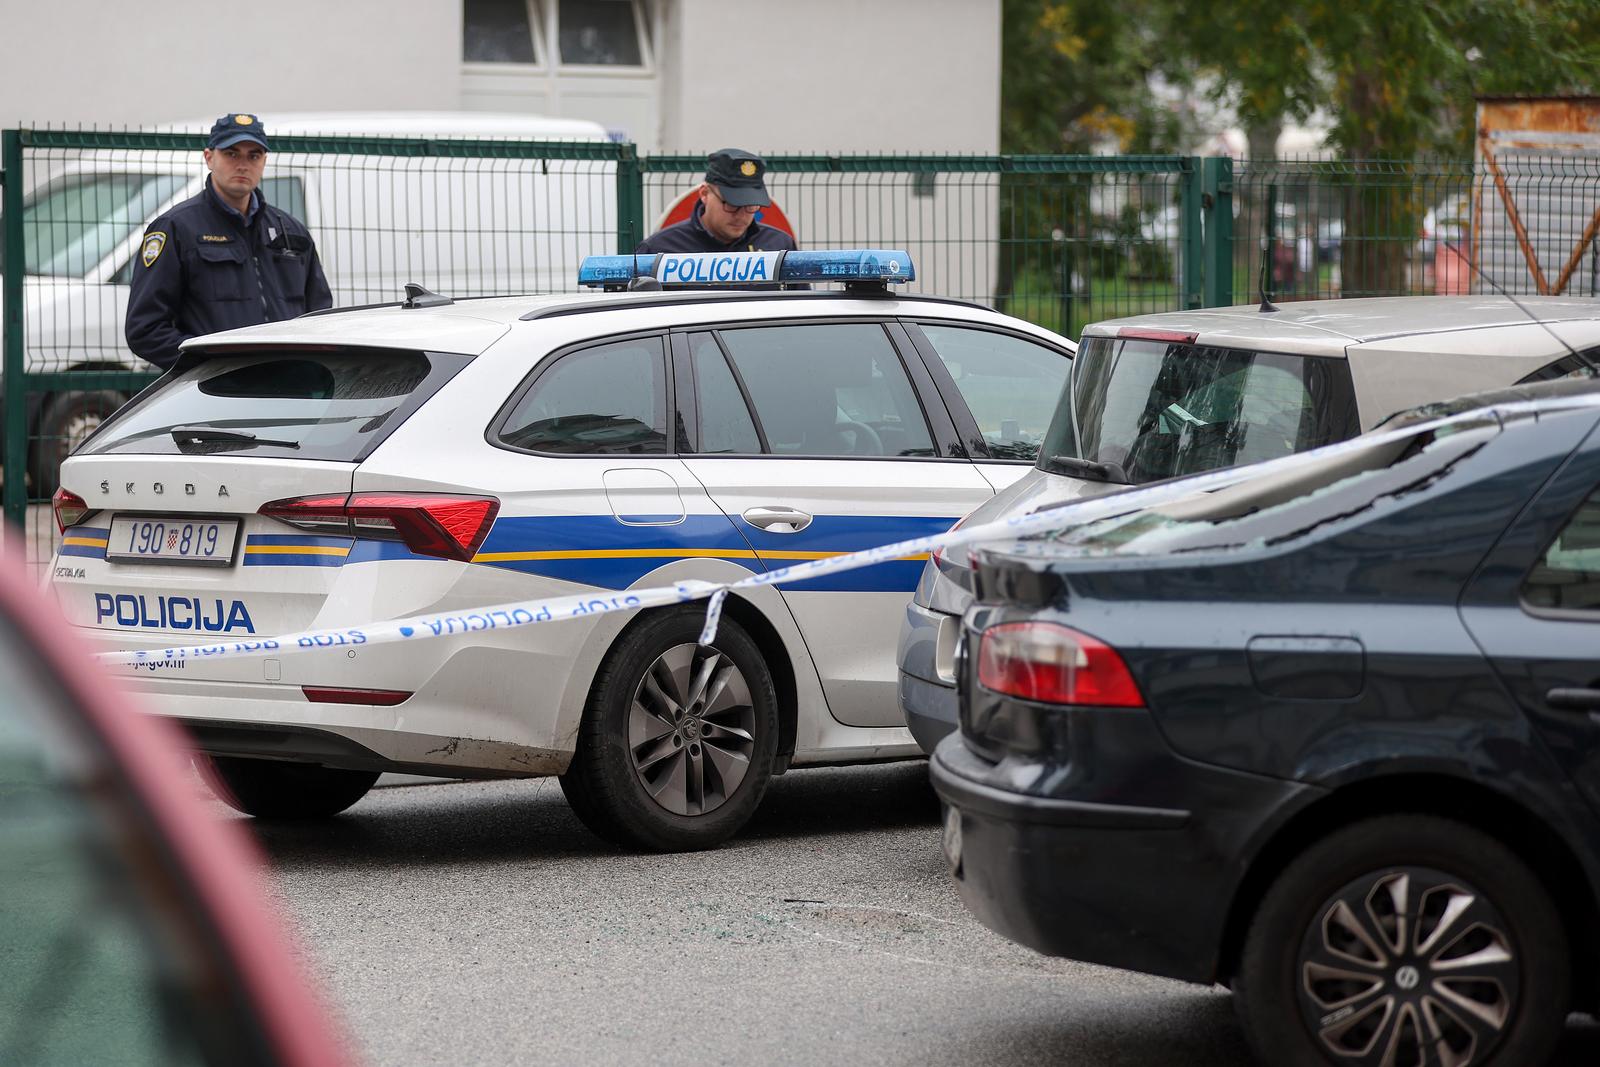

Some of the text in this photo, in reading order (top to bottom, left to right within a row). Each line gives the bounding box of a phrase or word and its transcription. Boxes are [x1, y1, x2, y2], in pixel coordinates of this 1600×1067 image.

[663, 256, 767, 282] POLICIJA
[129, 522, 218, 556] 190 819
[94, 592, 256, 634] POLICIJA
